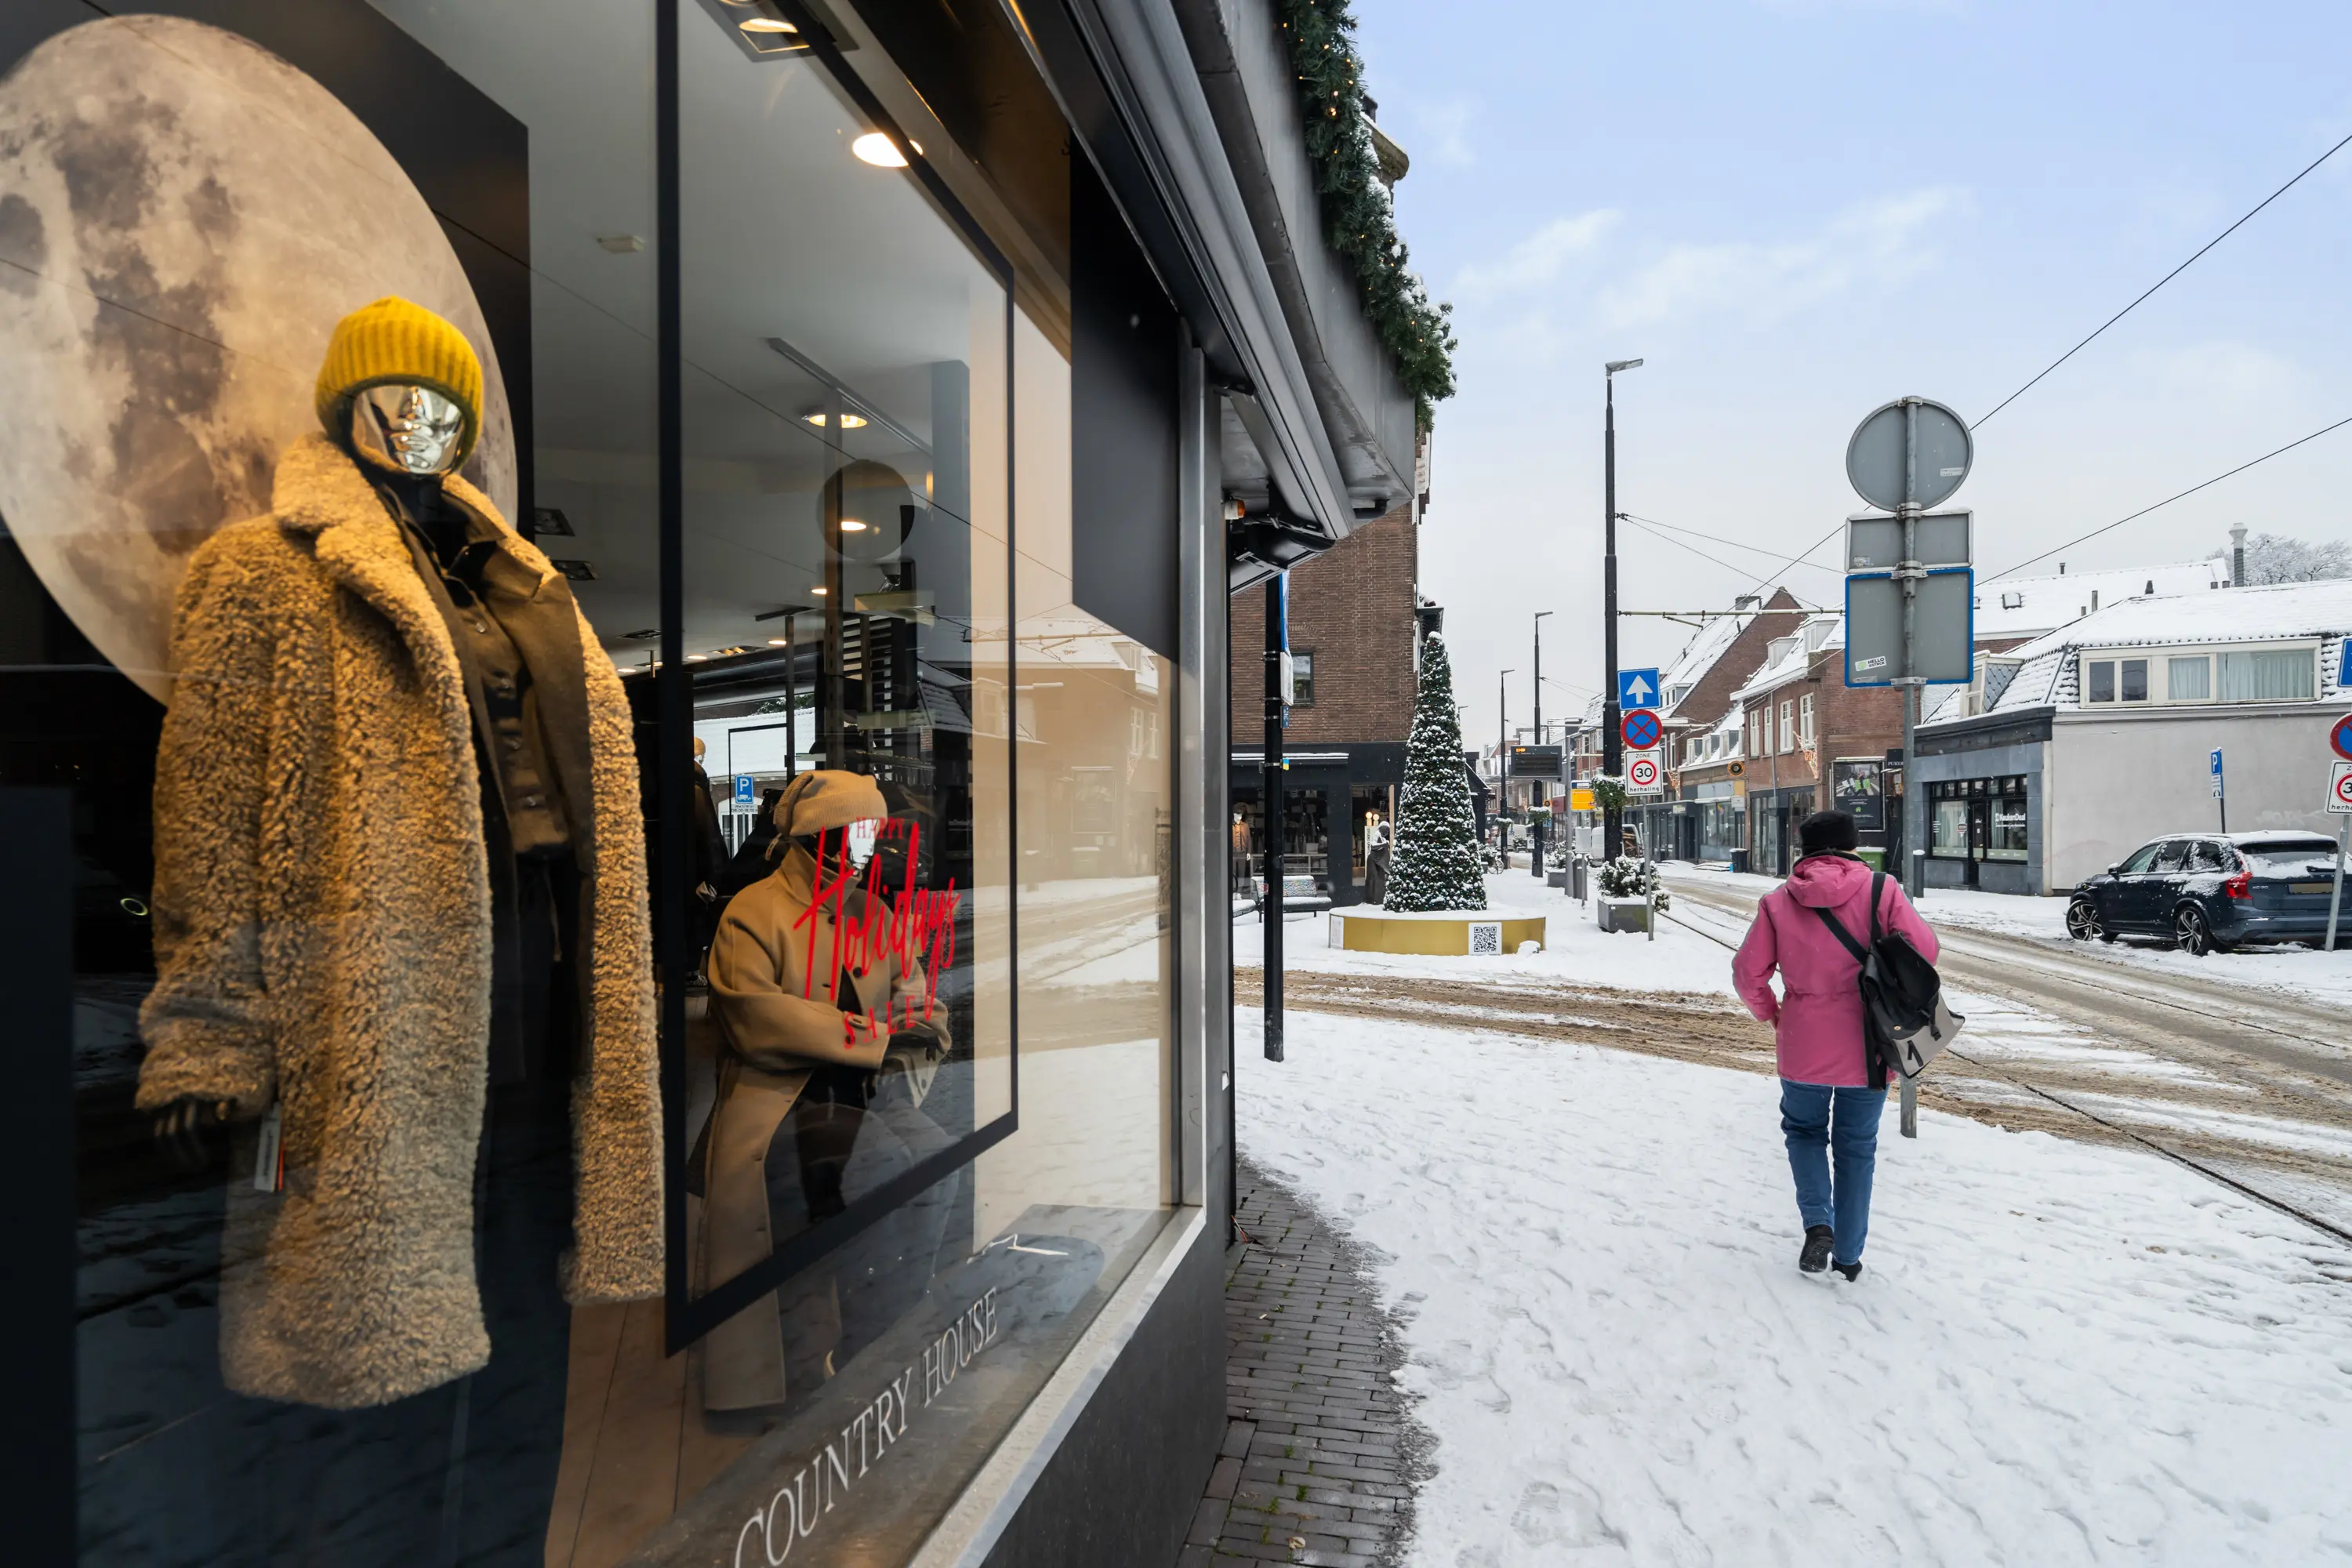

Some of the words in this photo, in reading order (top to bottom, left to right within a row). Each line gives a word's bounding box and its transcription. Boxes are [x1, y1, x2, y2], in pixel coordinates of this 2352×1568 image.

[1635, 768, 1653, 778] 30
[2212, 753, 2218, 772] P
[739, 778, 750, 792] P
[856, 816, 905, 840] HAPPY
[1999, 813, 2026, 822] KeukenDeal
[793, 822, 961, 1022] Holidays
[843, 995, 916, 1050] SALE
[735, 1367, 912, 1568] COUNTRY
[923, 1287, 998, 1408] HOUSE
